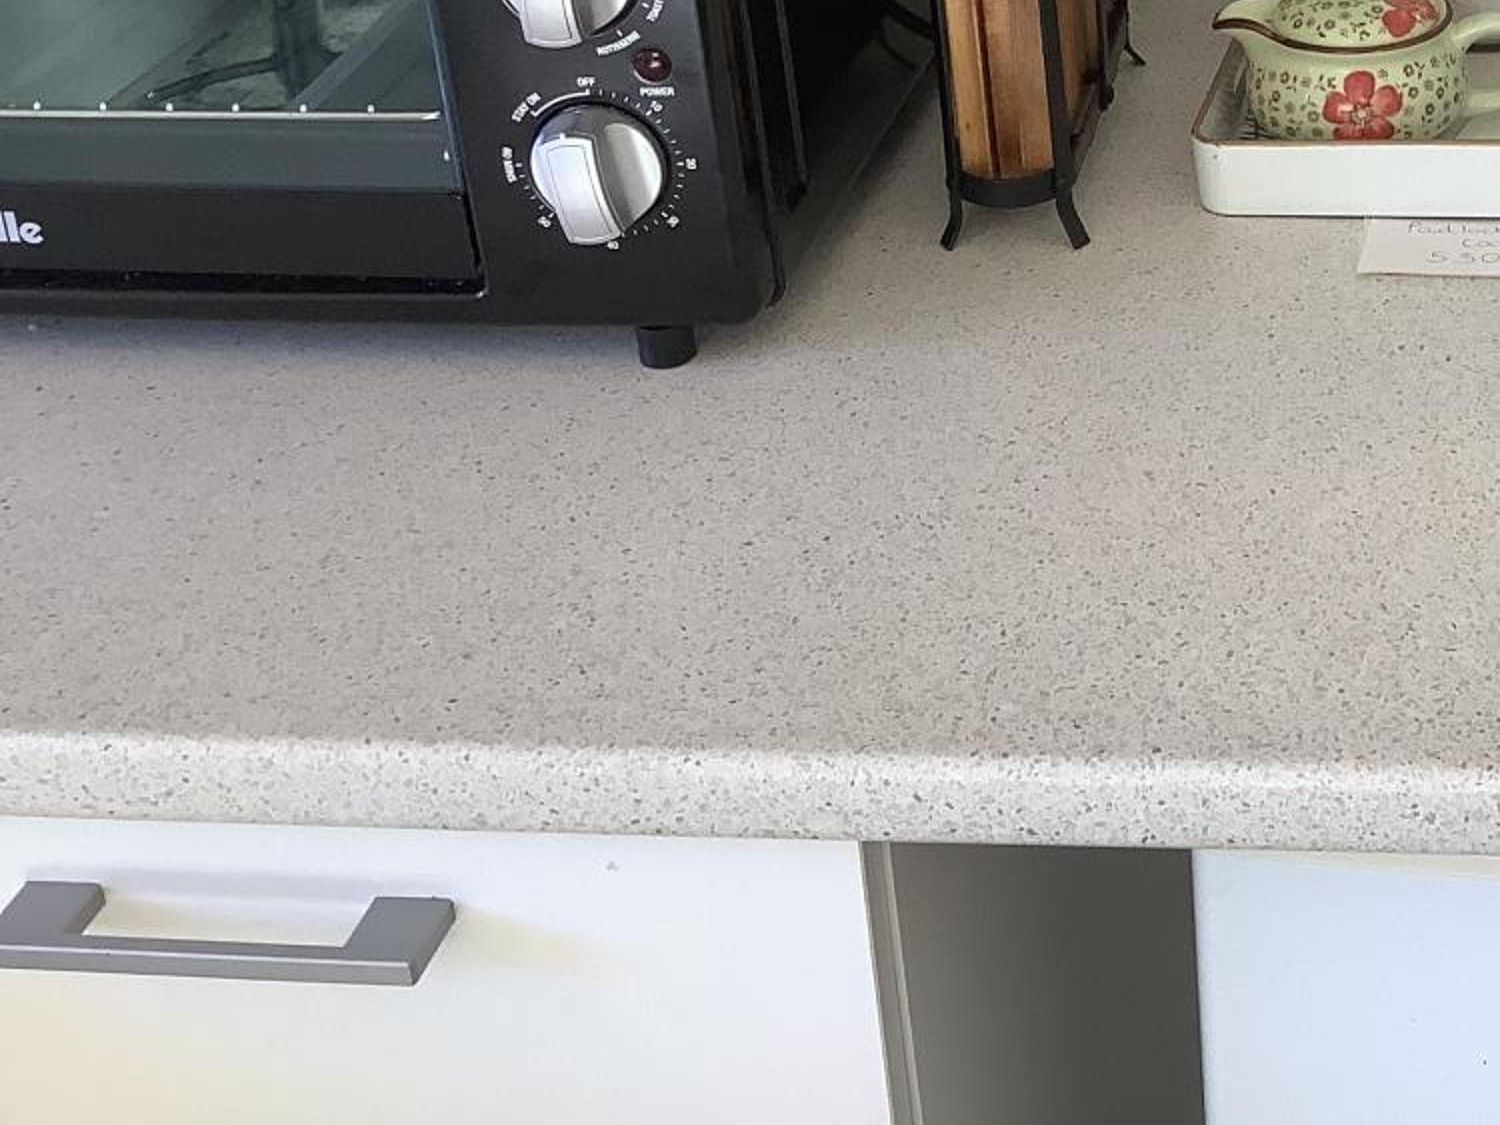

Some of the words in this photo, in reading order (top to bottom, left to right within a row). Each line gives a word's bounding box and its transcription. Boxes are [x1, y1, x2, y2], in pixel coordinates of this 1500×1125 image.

[577, 77, 595, 87] OFF
[640, 87, 675, 97] POWER
[511, 102, 530, 122] STAY
[526, 92, 541, 106] ON
[650, 101, 663, 112] 10
